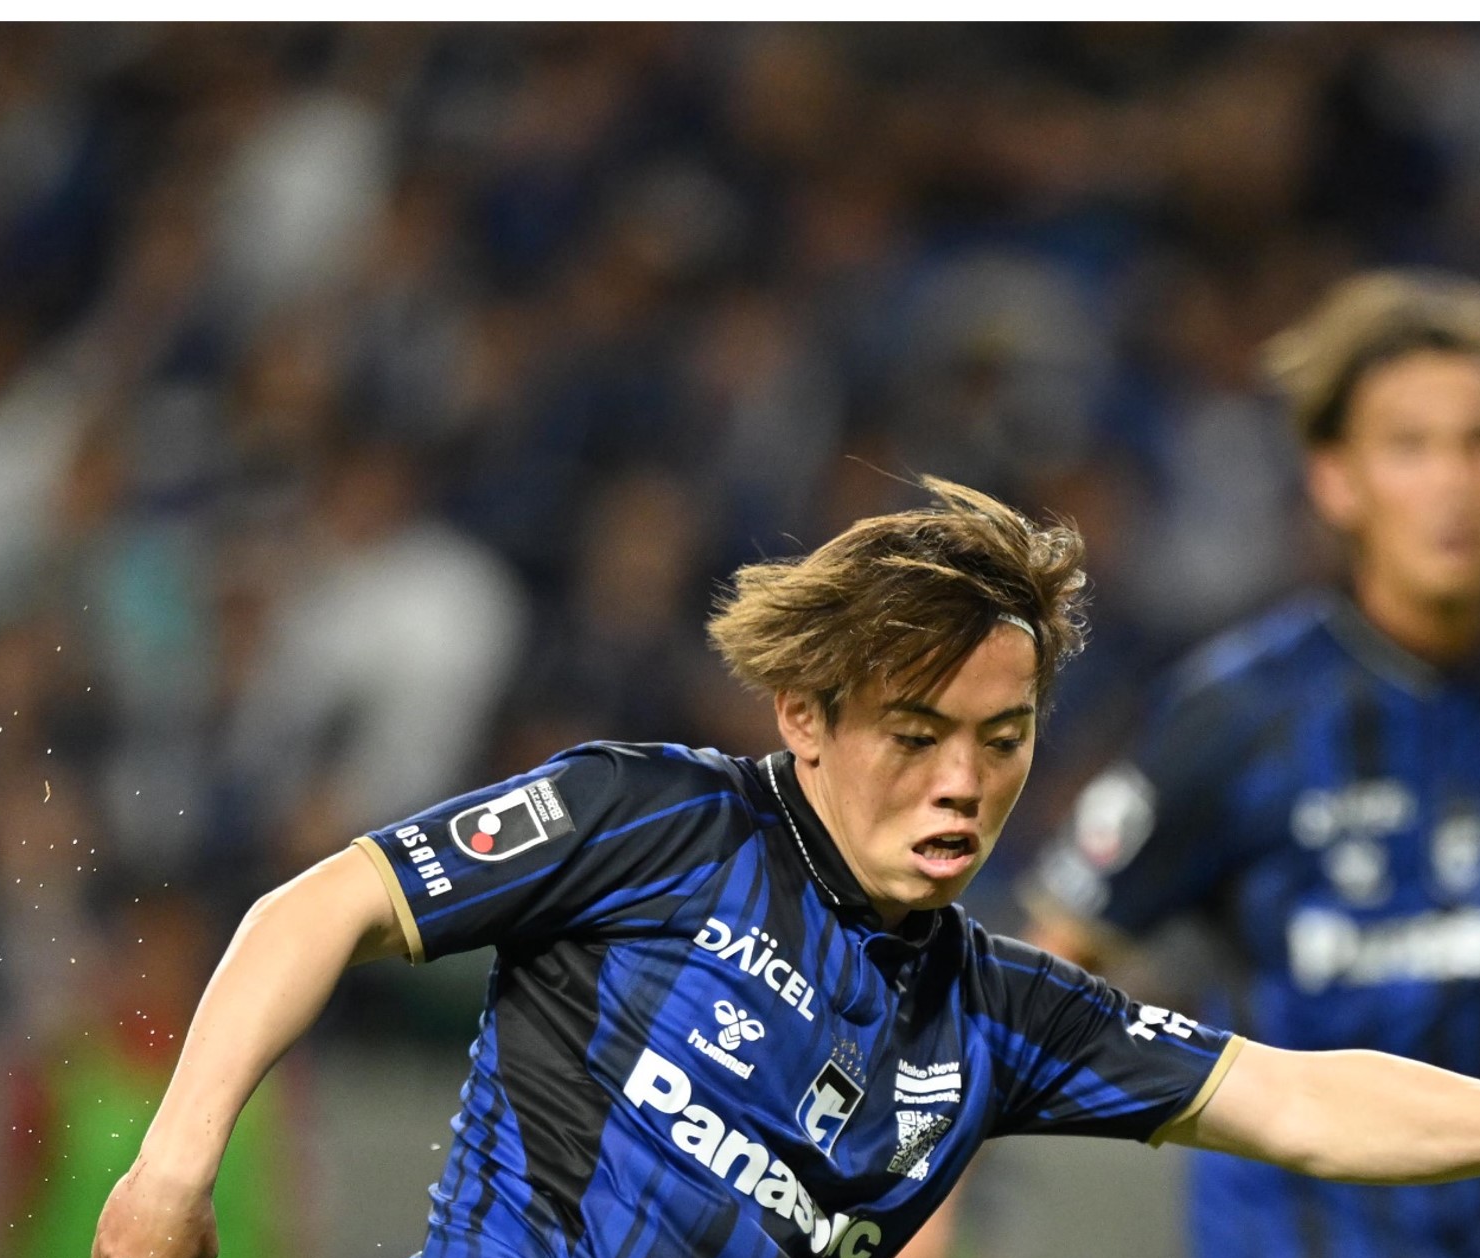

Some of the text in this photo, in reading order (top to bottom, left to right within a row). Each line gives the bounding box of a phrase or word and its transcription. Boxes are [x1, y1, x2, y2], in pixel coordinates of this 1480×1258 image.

[395, 824, 453, 898] OSAKA
[687, 1028, 755, 1080] hummel
[898, 1058, 960, 1079] Make New
[894, 1089, 961, 1105] Panasonic
